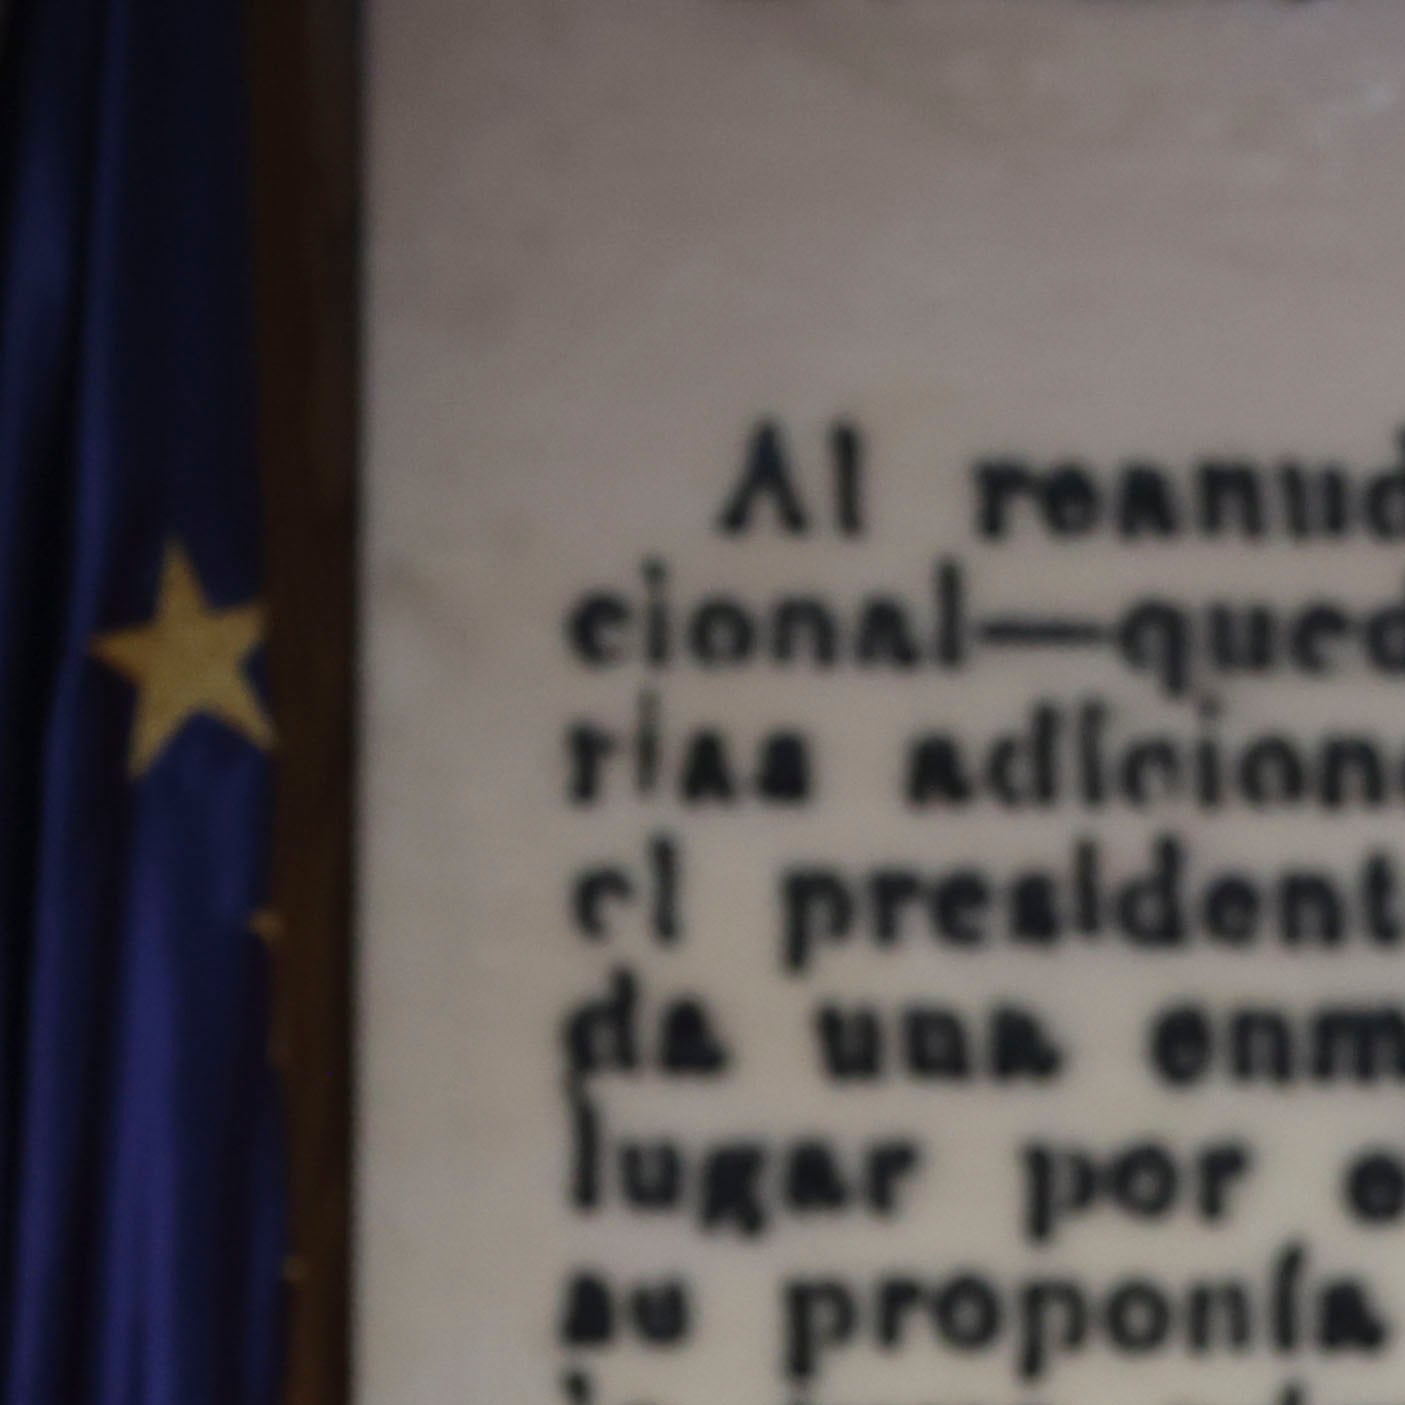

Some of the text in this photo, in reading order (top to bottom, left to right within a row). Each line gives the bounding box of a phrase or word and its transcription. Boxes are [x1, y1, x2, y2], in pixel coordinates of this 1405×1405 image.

[718, 422, 863, 537] Al
[566, 702, 812, 806] rias
[570, 835, 680, 945] el
[560, 967, 730, 1086] da
[815, 1006, 1062, 1082] una
[563, 1087, 920, 1239] lugar
[1021, 1141, 1251, 1246] por
[781, 1243, 1390, 1386] proponía
